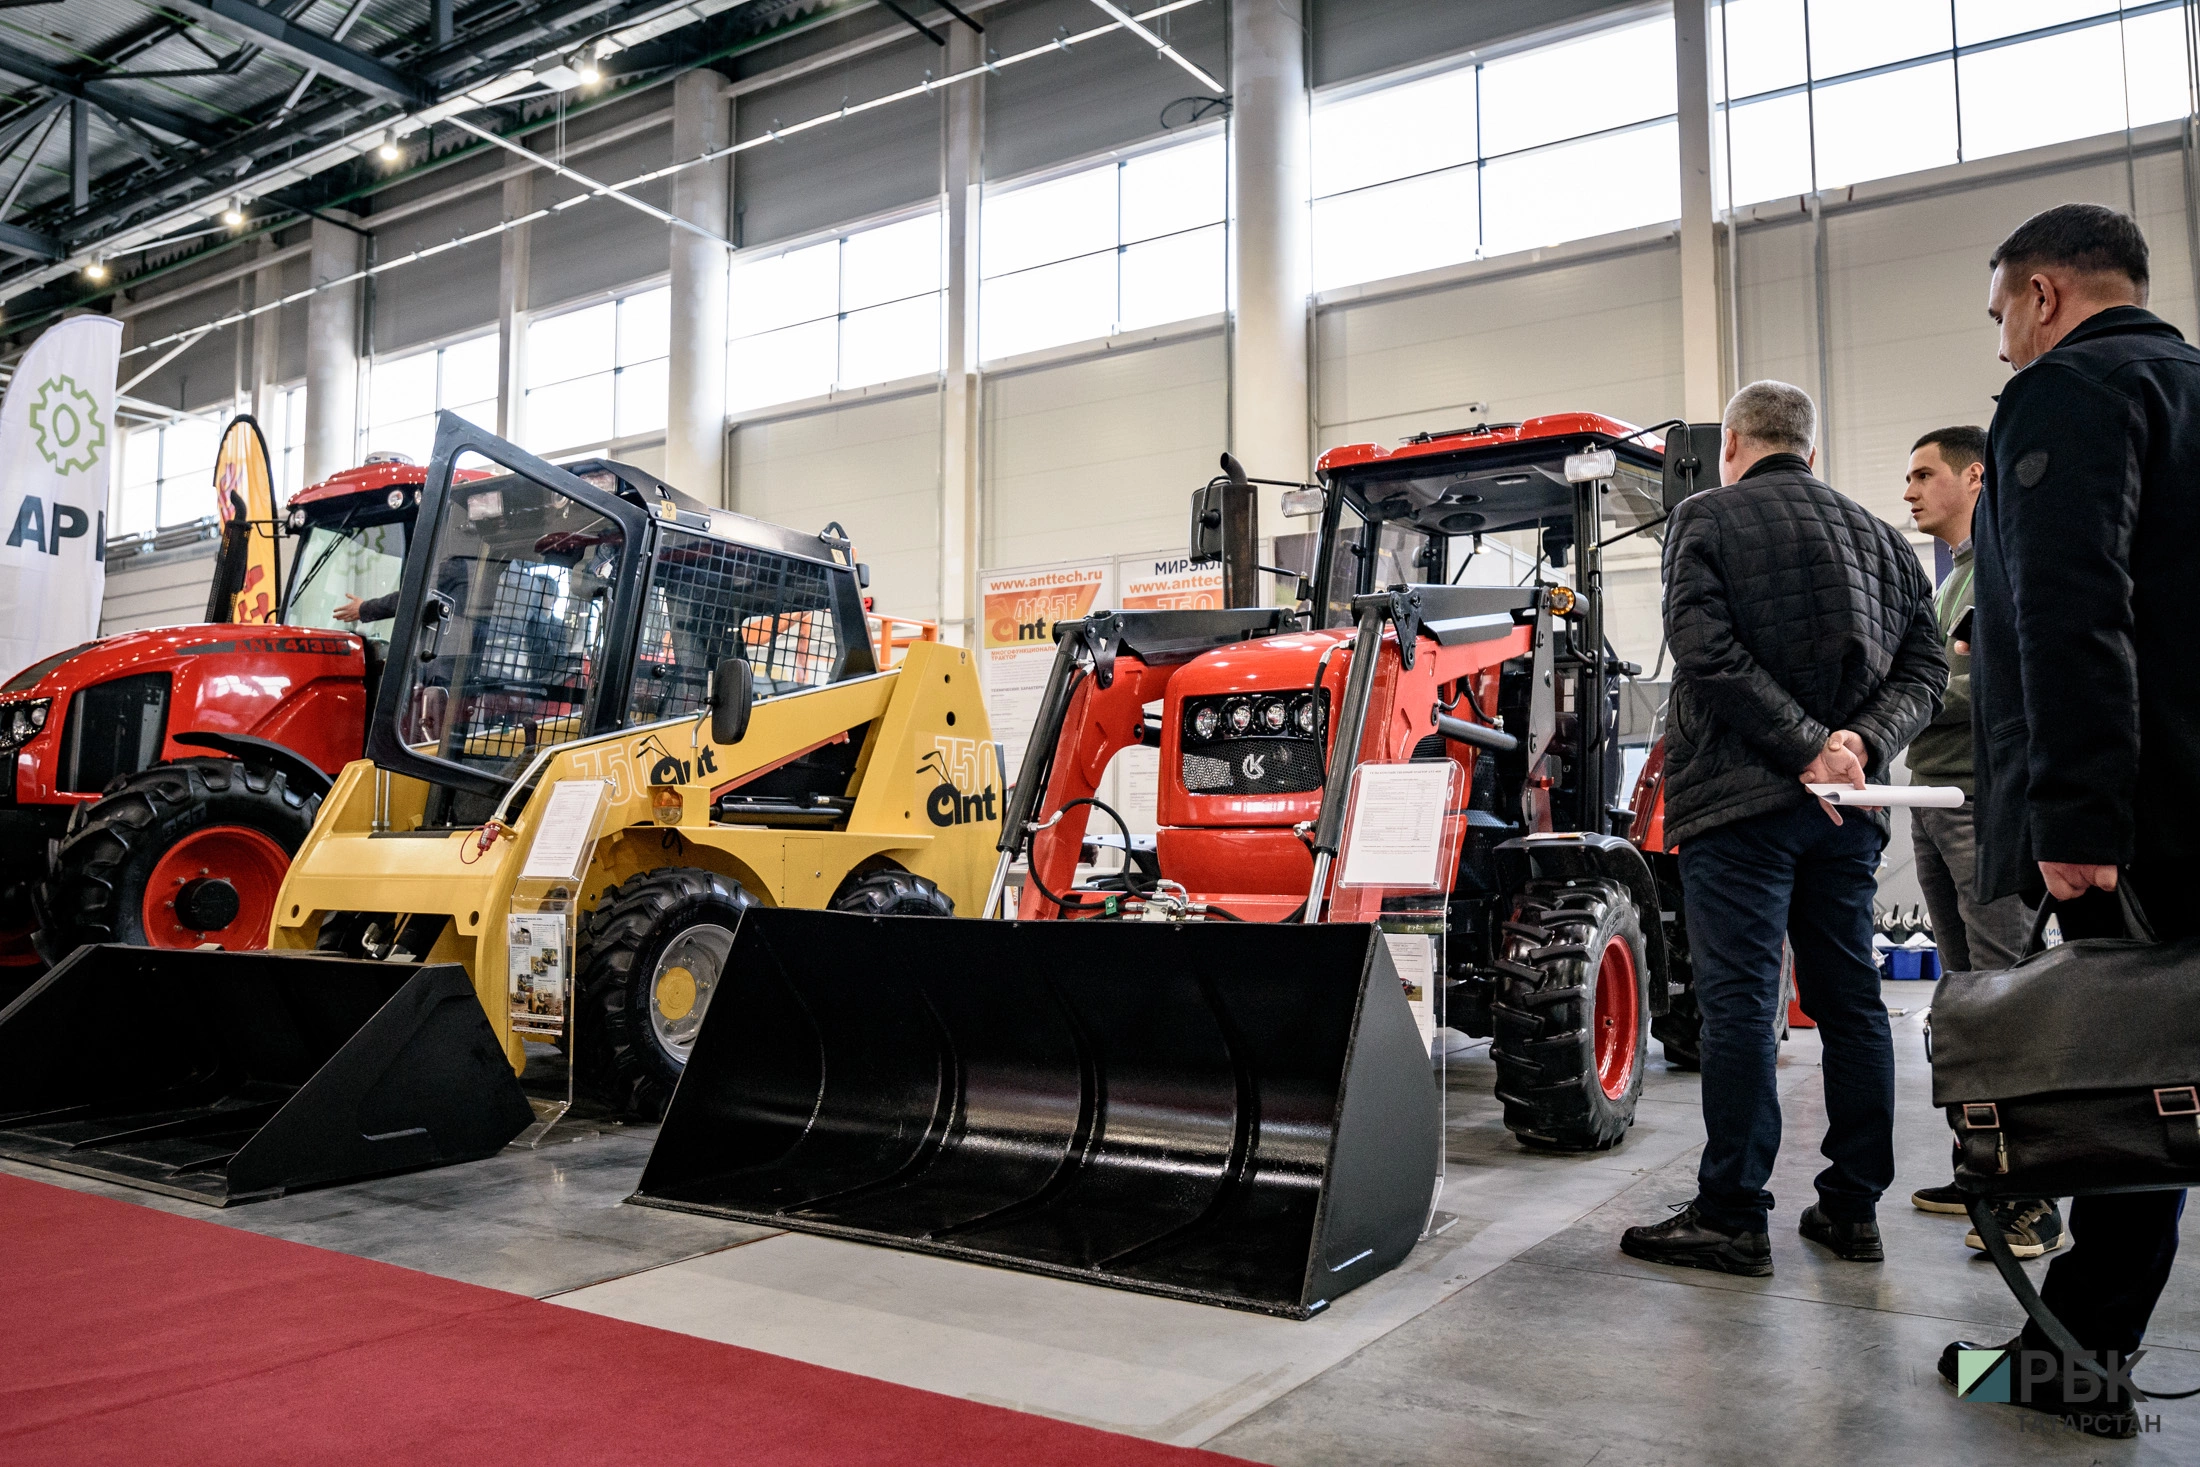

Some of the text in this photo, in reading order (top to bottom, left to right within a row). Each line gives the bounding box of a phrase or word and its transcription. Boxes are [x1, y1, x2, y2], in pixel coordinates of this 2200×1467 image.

[990, 570, 1103, 591] www.anttech.ru
[1013, 593, 1077, 622] 4135F
[991, 616, 1047, 643] ant
[233, 639, 280, 653] ANT
[572, 737, 658, 806] 750
[935, 735, 999, 798] 750
[926, 783, 997, 828] ant
